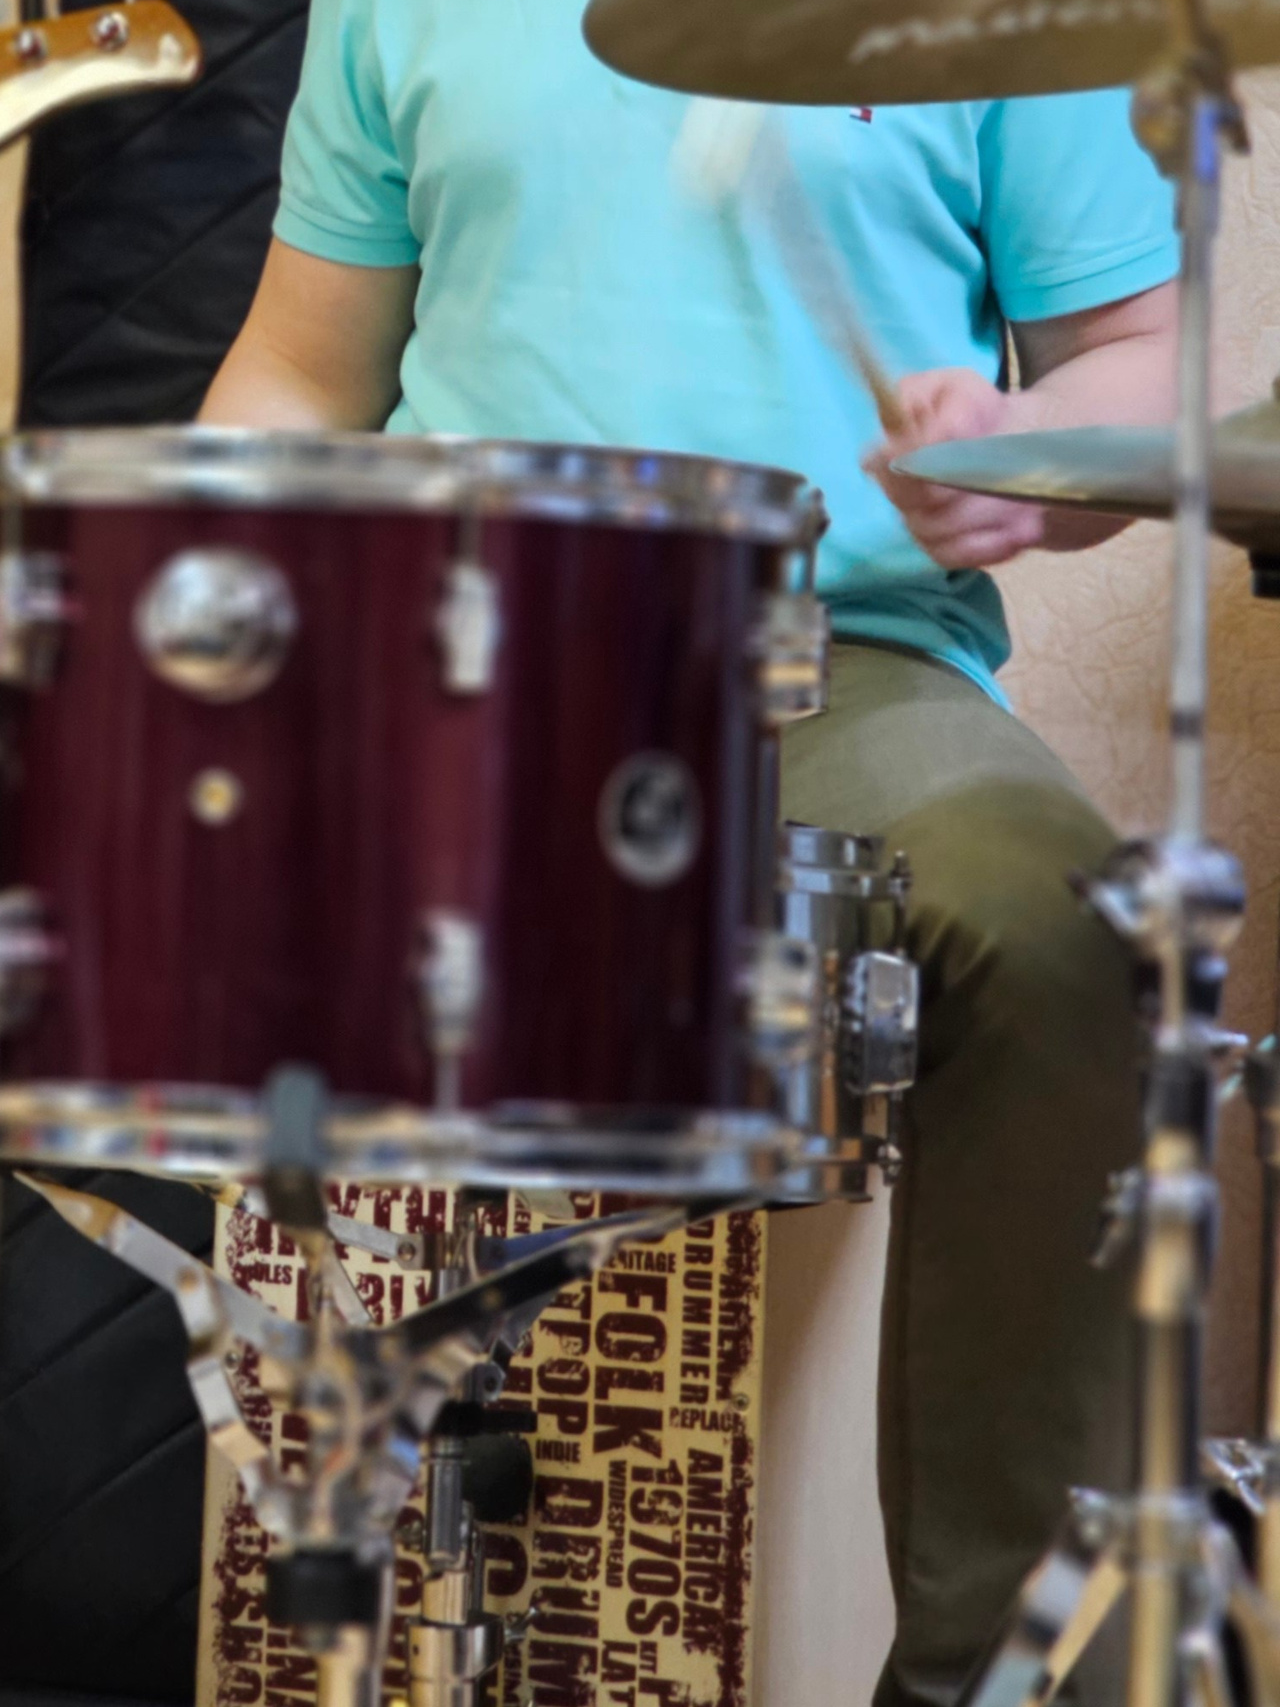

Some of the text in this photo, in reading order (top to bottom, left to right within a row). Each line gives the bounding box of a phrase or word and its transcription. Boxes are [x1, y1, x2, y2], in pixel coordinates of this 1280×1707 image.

[592, 1270, 669, 1460] FOLK
[678, 1216, 715, 1405] DRUMMER
[535, 1438, 581, 1464] INDIE
[605, 1459, 627, 1589] WIDESPREAD
[625, 1458, 684, 1637] 1970S
